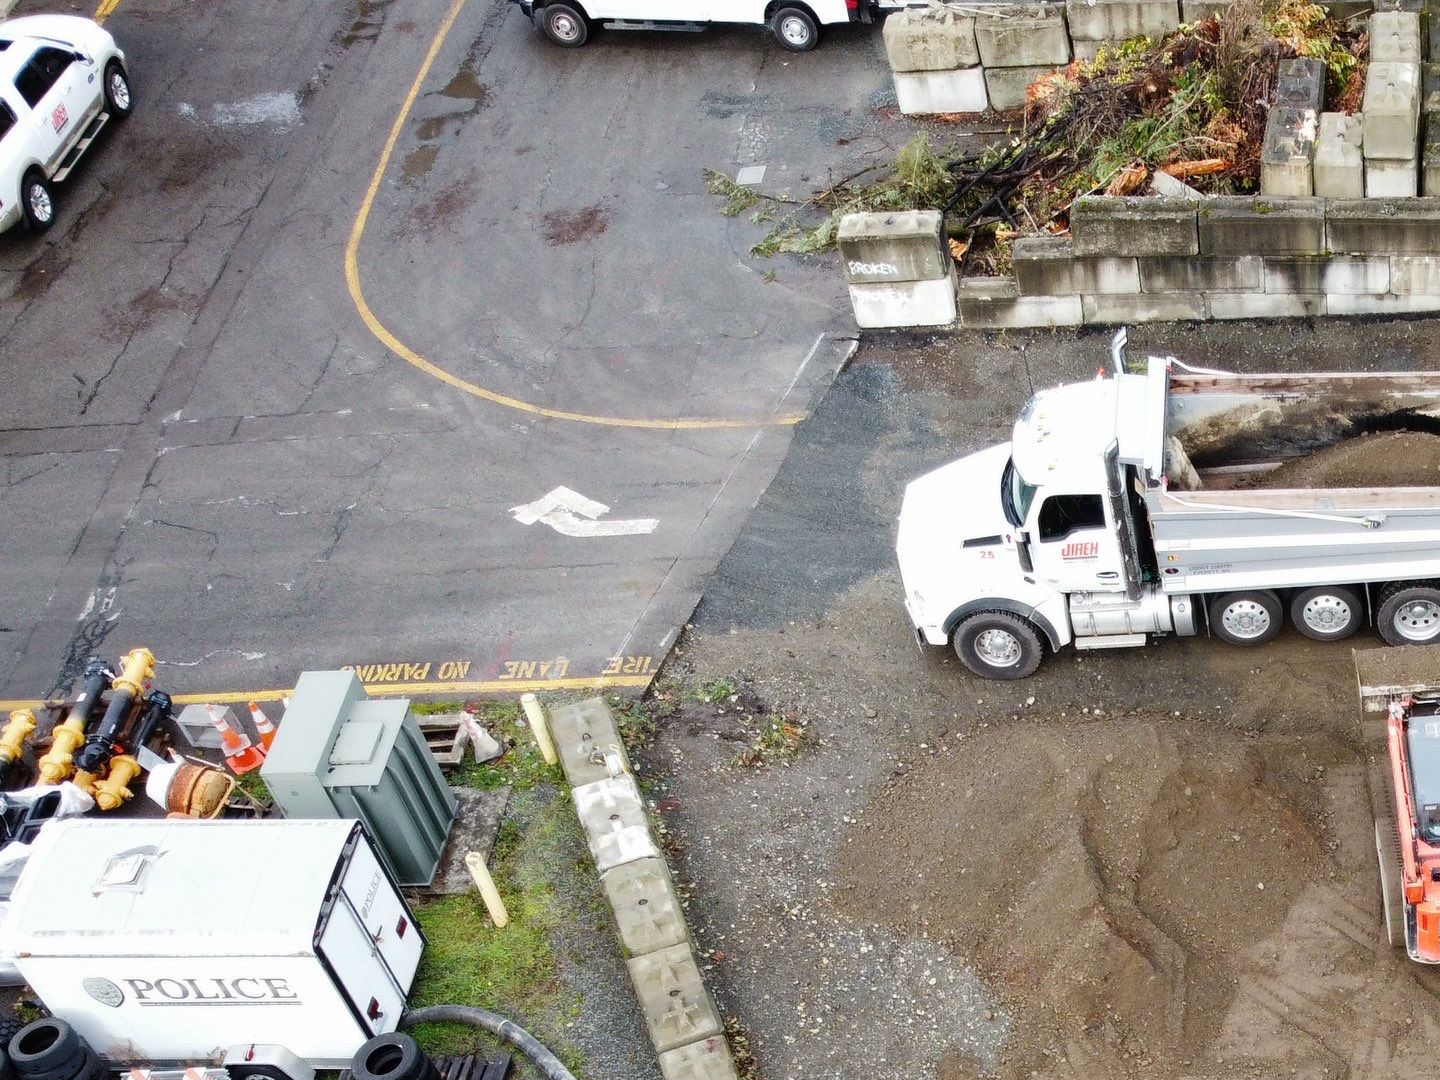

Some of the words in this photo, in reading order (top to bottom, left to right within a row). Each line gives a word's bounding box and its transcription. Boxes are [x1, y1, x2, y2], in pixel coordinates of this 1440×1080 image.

[848, 261, 898, 275] BROKEN
[980, 551, 995, 560] 25
[1061, 541, 1099, 557] JIREH
[340, 661, 431, 683] PARKIN
[438, 660, 471, 680] NO
[499, 656, 571, 680] LANE
[602, 656, 658, 675] IRE
[122, 978, 298, 1000] POLICE
